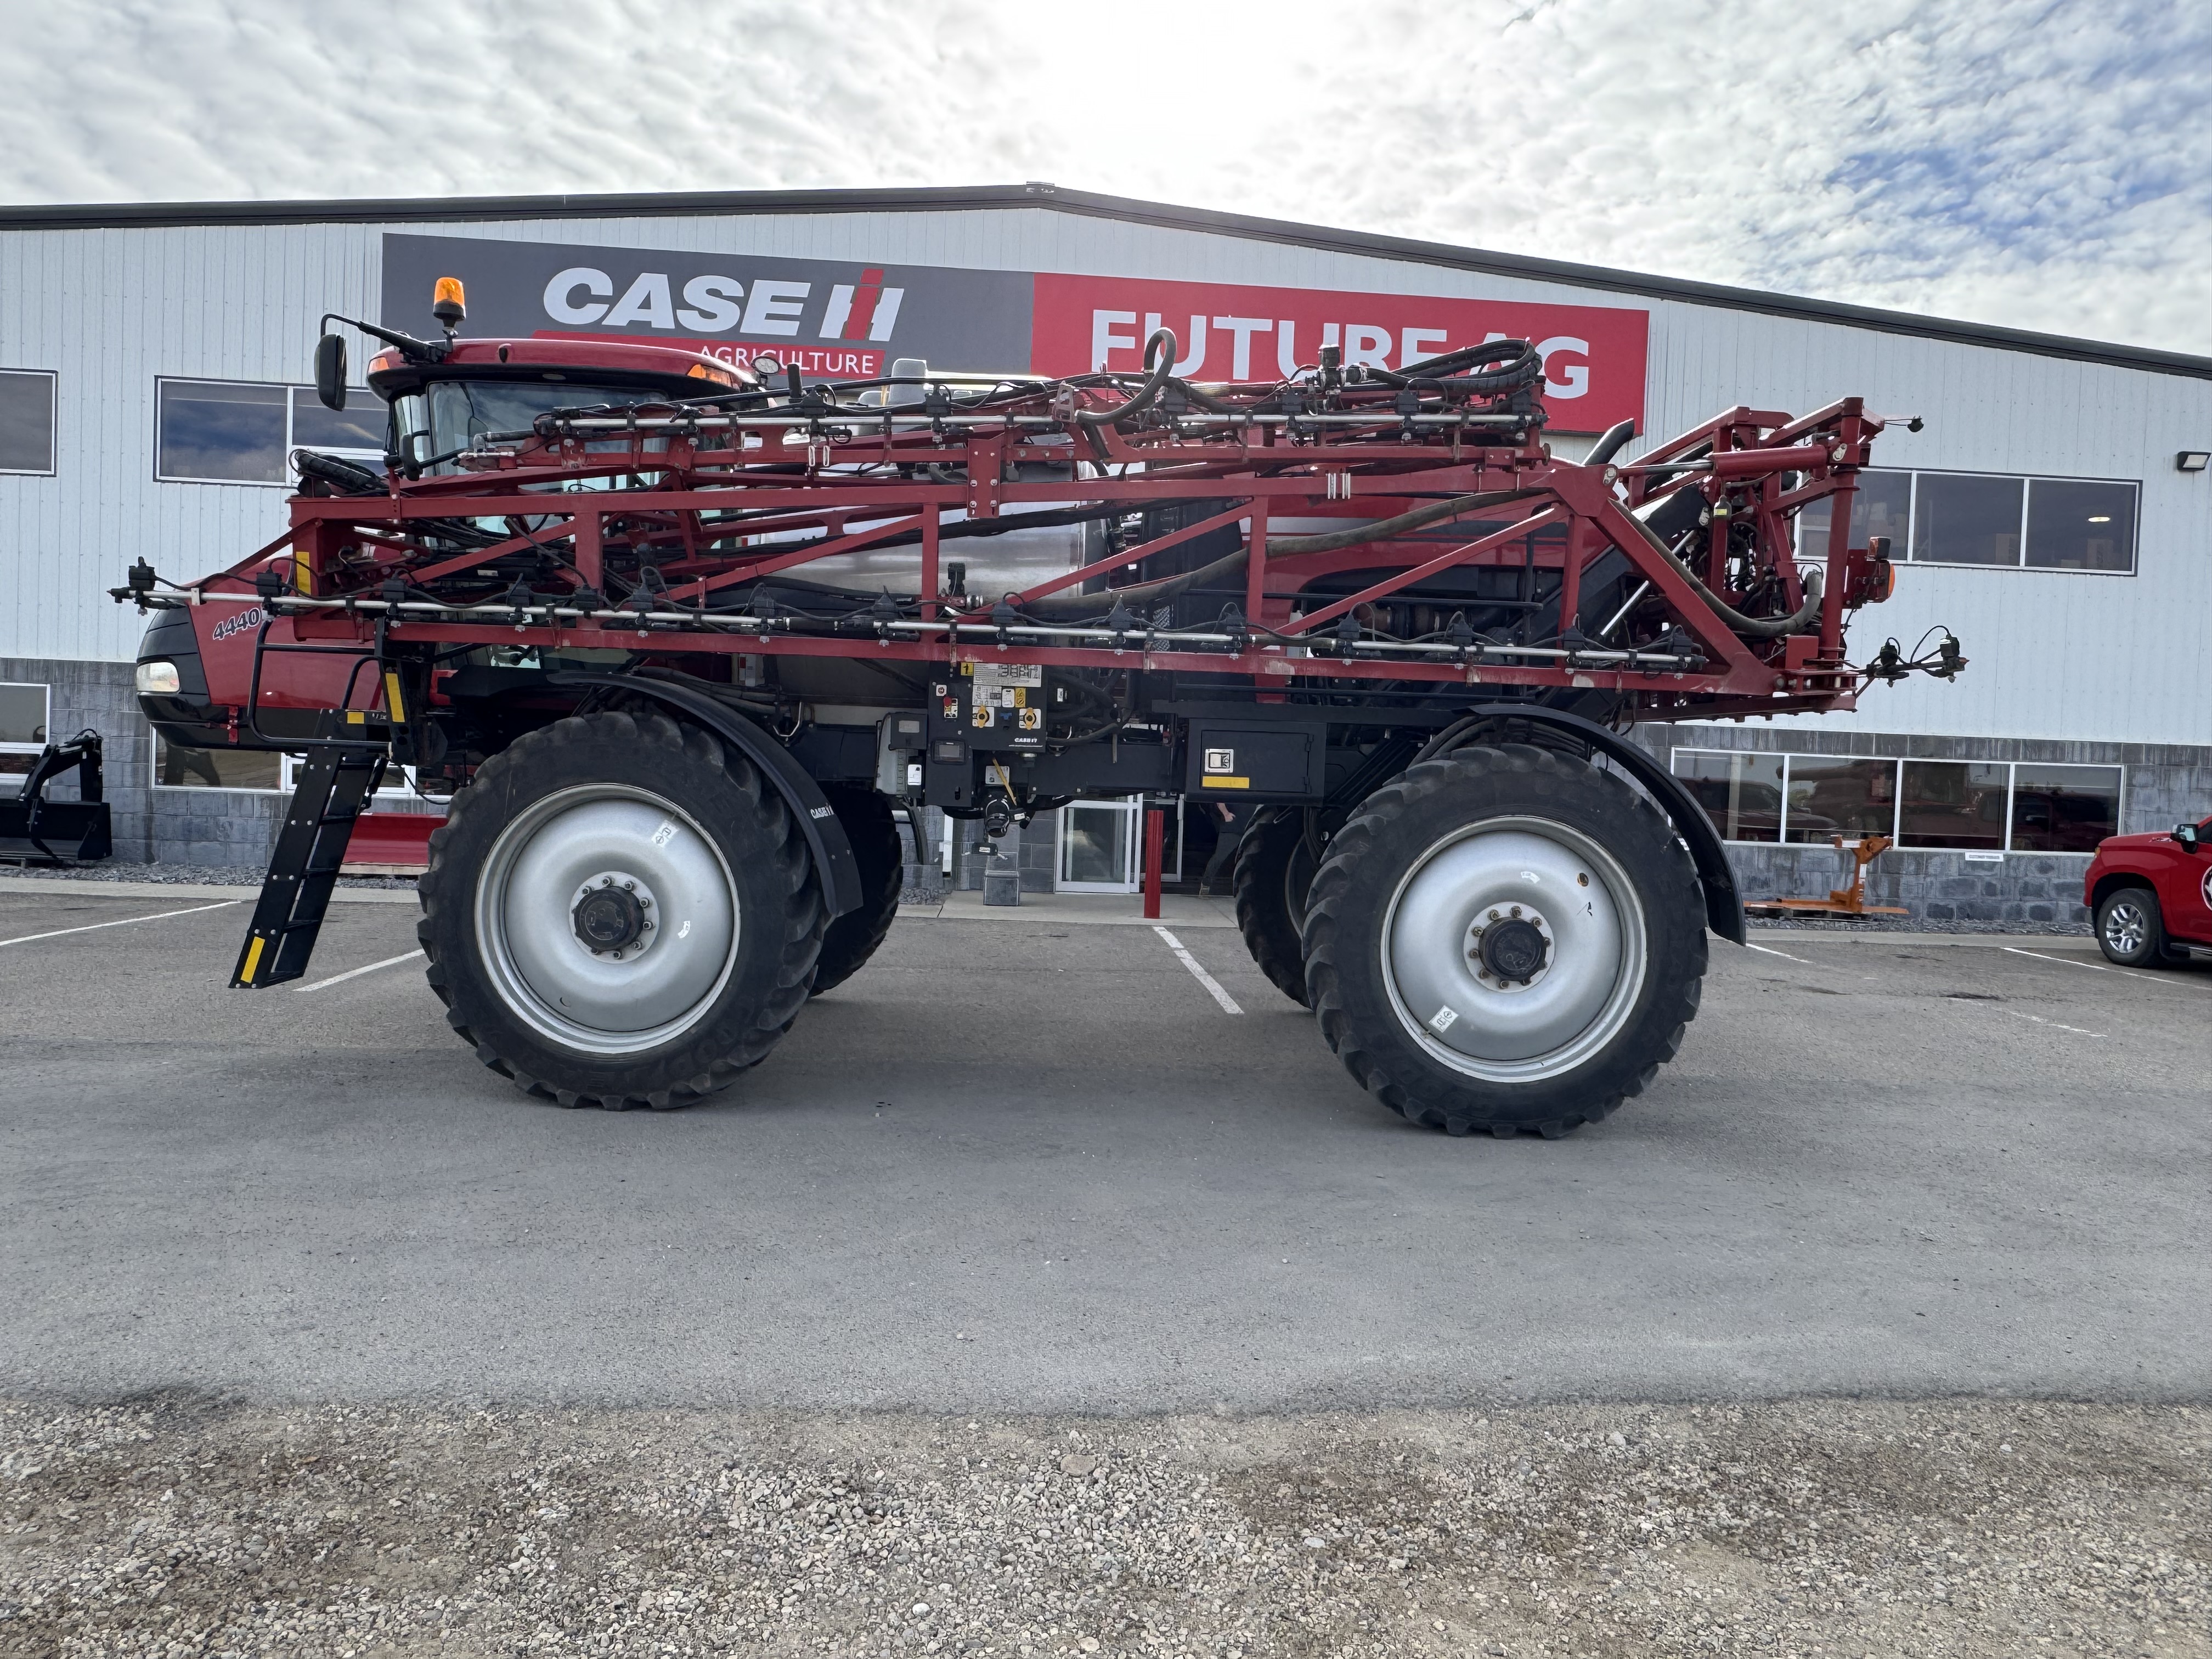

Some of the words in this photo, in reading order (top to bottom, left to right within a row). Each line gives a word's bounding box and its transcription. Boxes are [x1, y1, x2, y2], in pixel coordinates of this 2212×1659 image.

[544, 267, 811, 336] CASE
[1092, 309, 1447, 381] FUTURE
[213, 607, 261, 640] 4440
